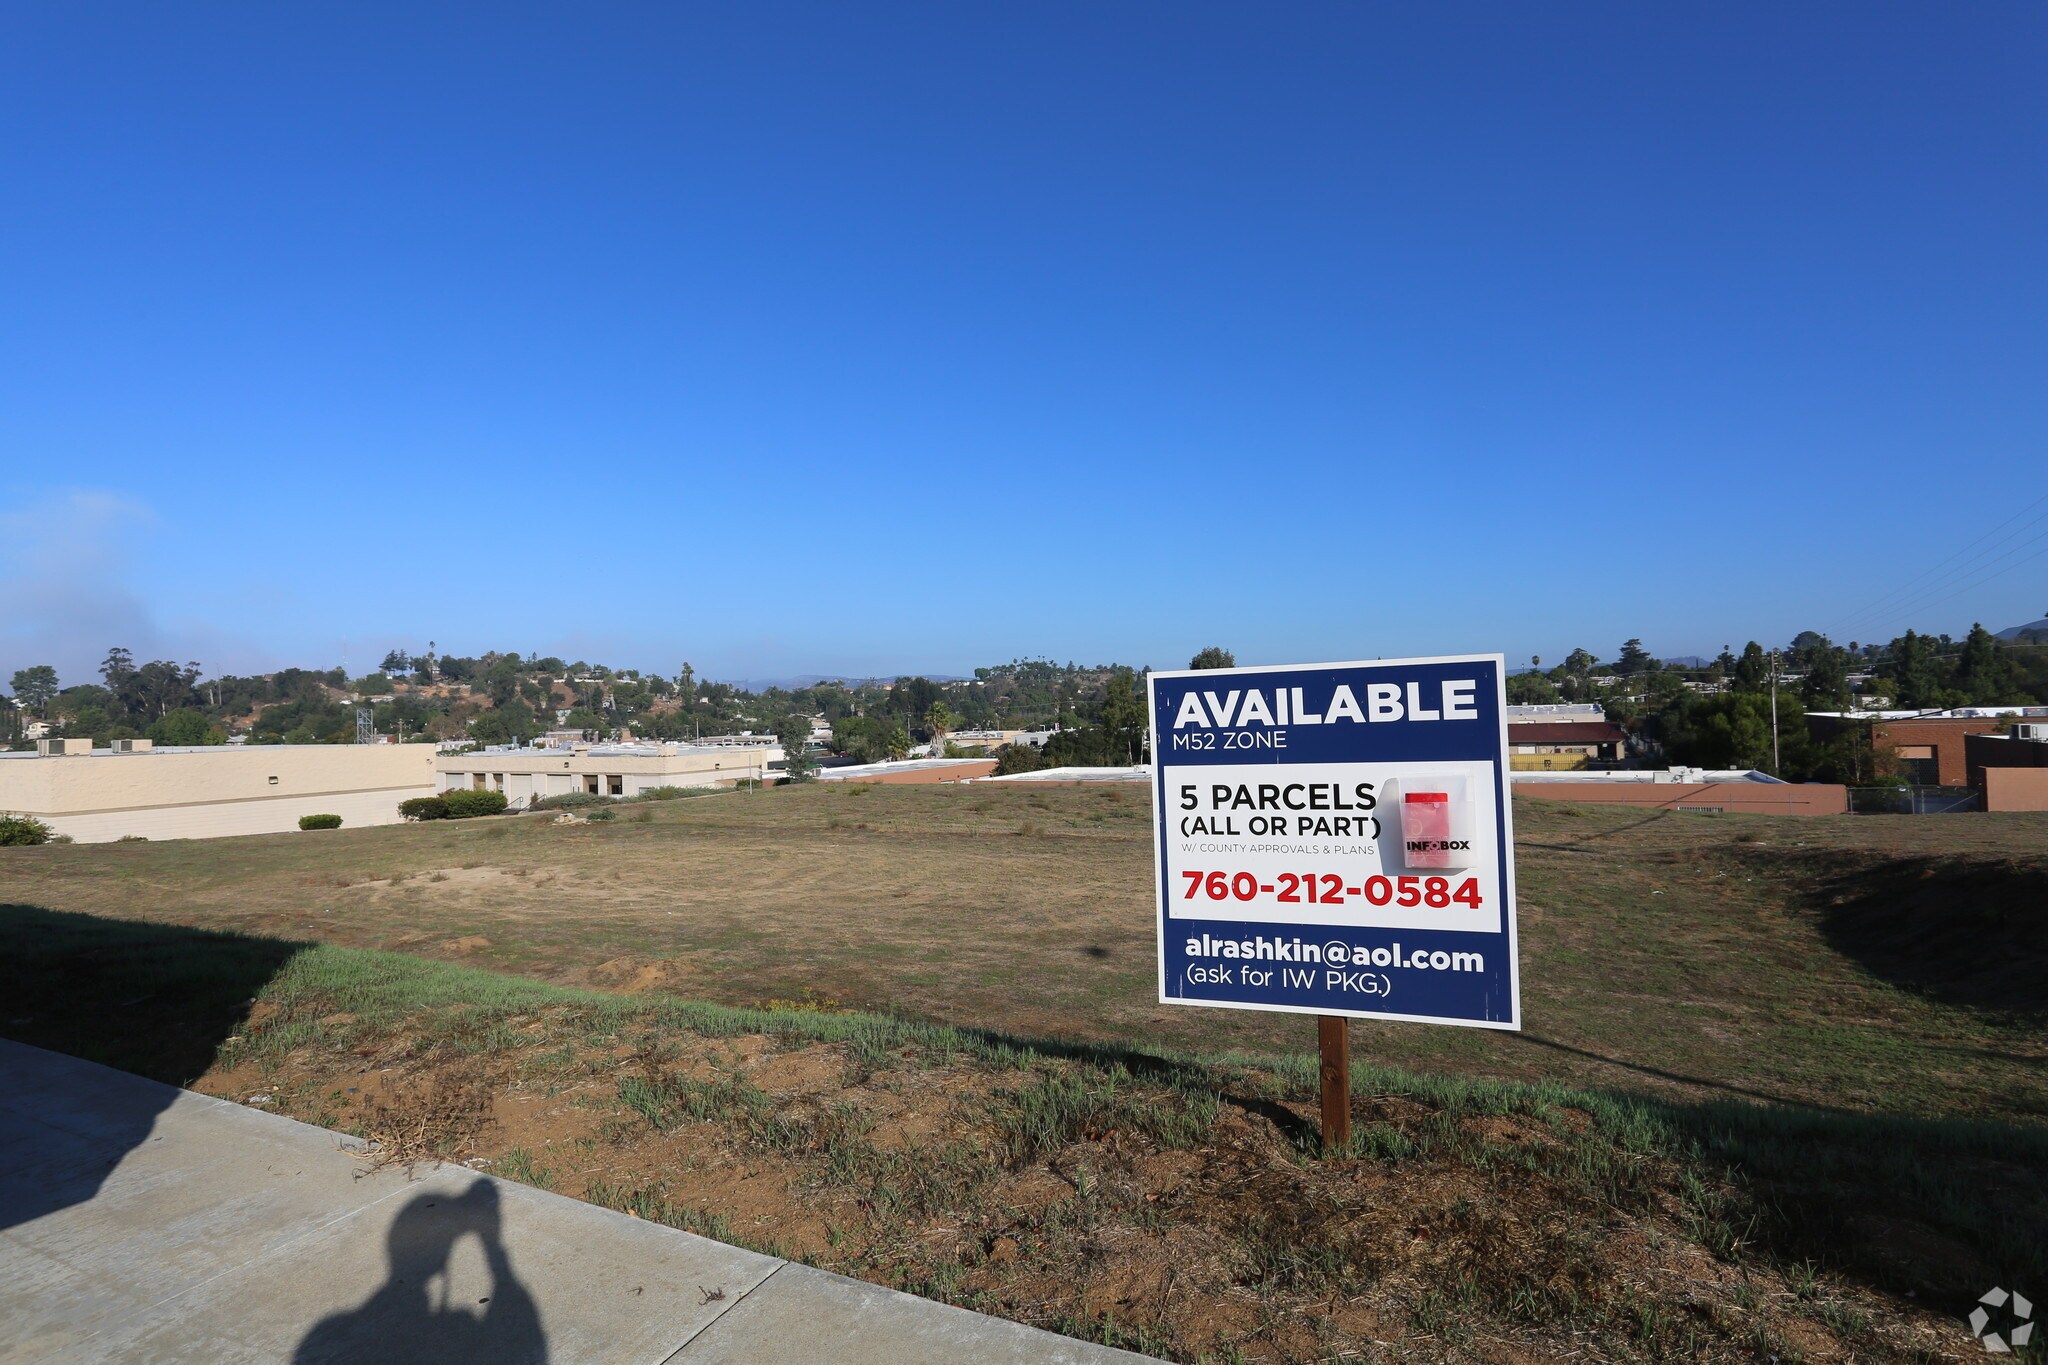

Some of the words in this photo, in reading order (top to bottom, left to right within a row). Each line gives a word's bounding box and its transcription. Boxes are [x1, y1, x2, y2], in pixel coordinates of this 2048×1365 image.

[1173, 679, 1478, 729] AVAILABLE
[1173, 732, 1215, 750] M52
[1223, 731, 1287, 749] ZONE
[1180, 785, 1198, 810] 5
[1212, 783, 1376, 810] PARCELS
[1181, 816, 1240, 838] (ALL
[1249, 816, 1287, 836] OR
[1298, 816, 1381, 840] PART)
[1181, 843, 1197, 853] W/
[1200, 844, 1246, 853] COUNTY
[1250, 844, 1319, 854] APPROVALS
[1322, 845, 1330, 854] &
[1334, 845, 1374, 855] PLANS
[1182, 871, 1483, 909] 760-212-0584
[1185, 934, 1484, 972] alrashkin@aol.com
[1187, 963, 1232, 985] (ask
[1241, 965, 1273, 987] for
[1283, 968, 1316, 989] IW
[1326, 971, 1391, 998] PKG.)
